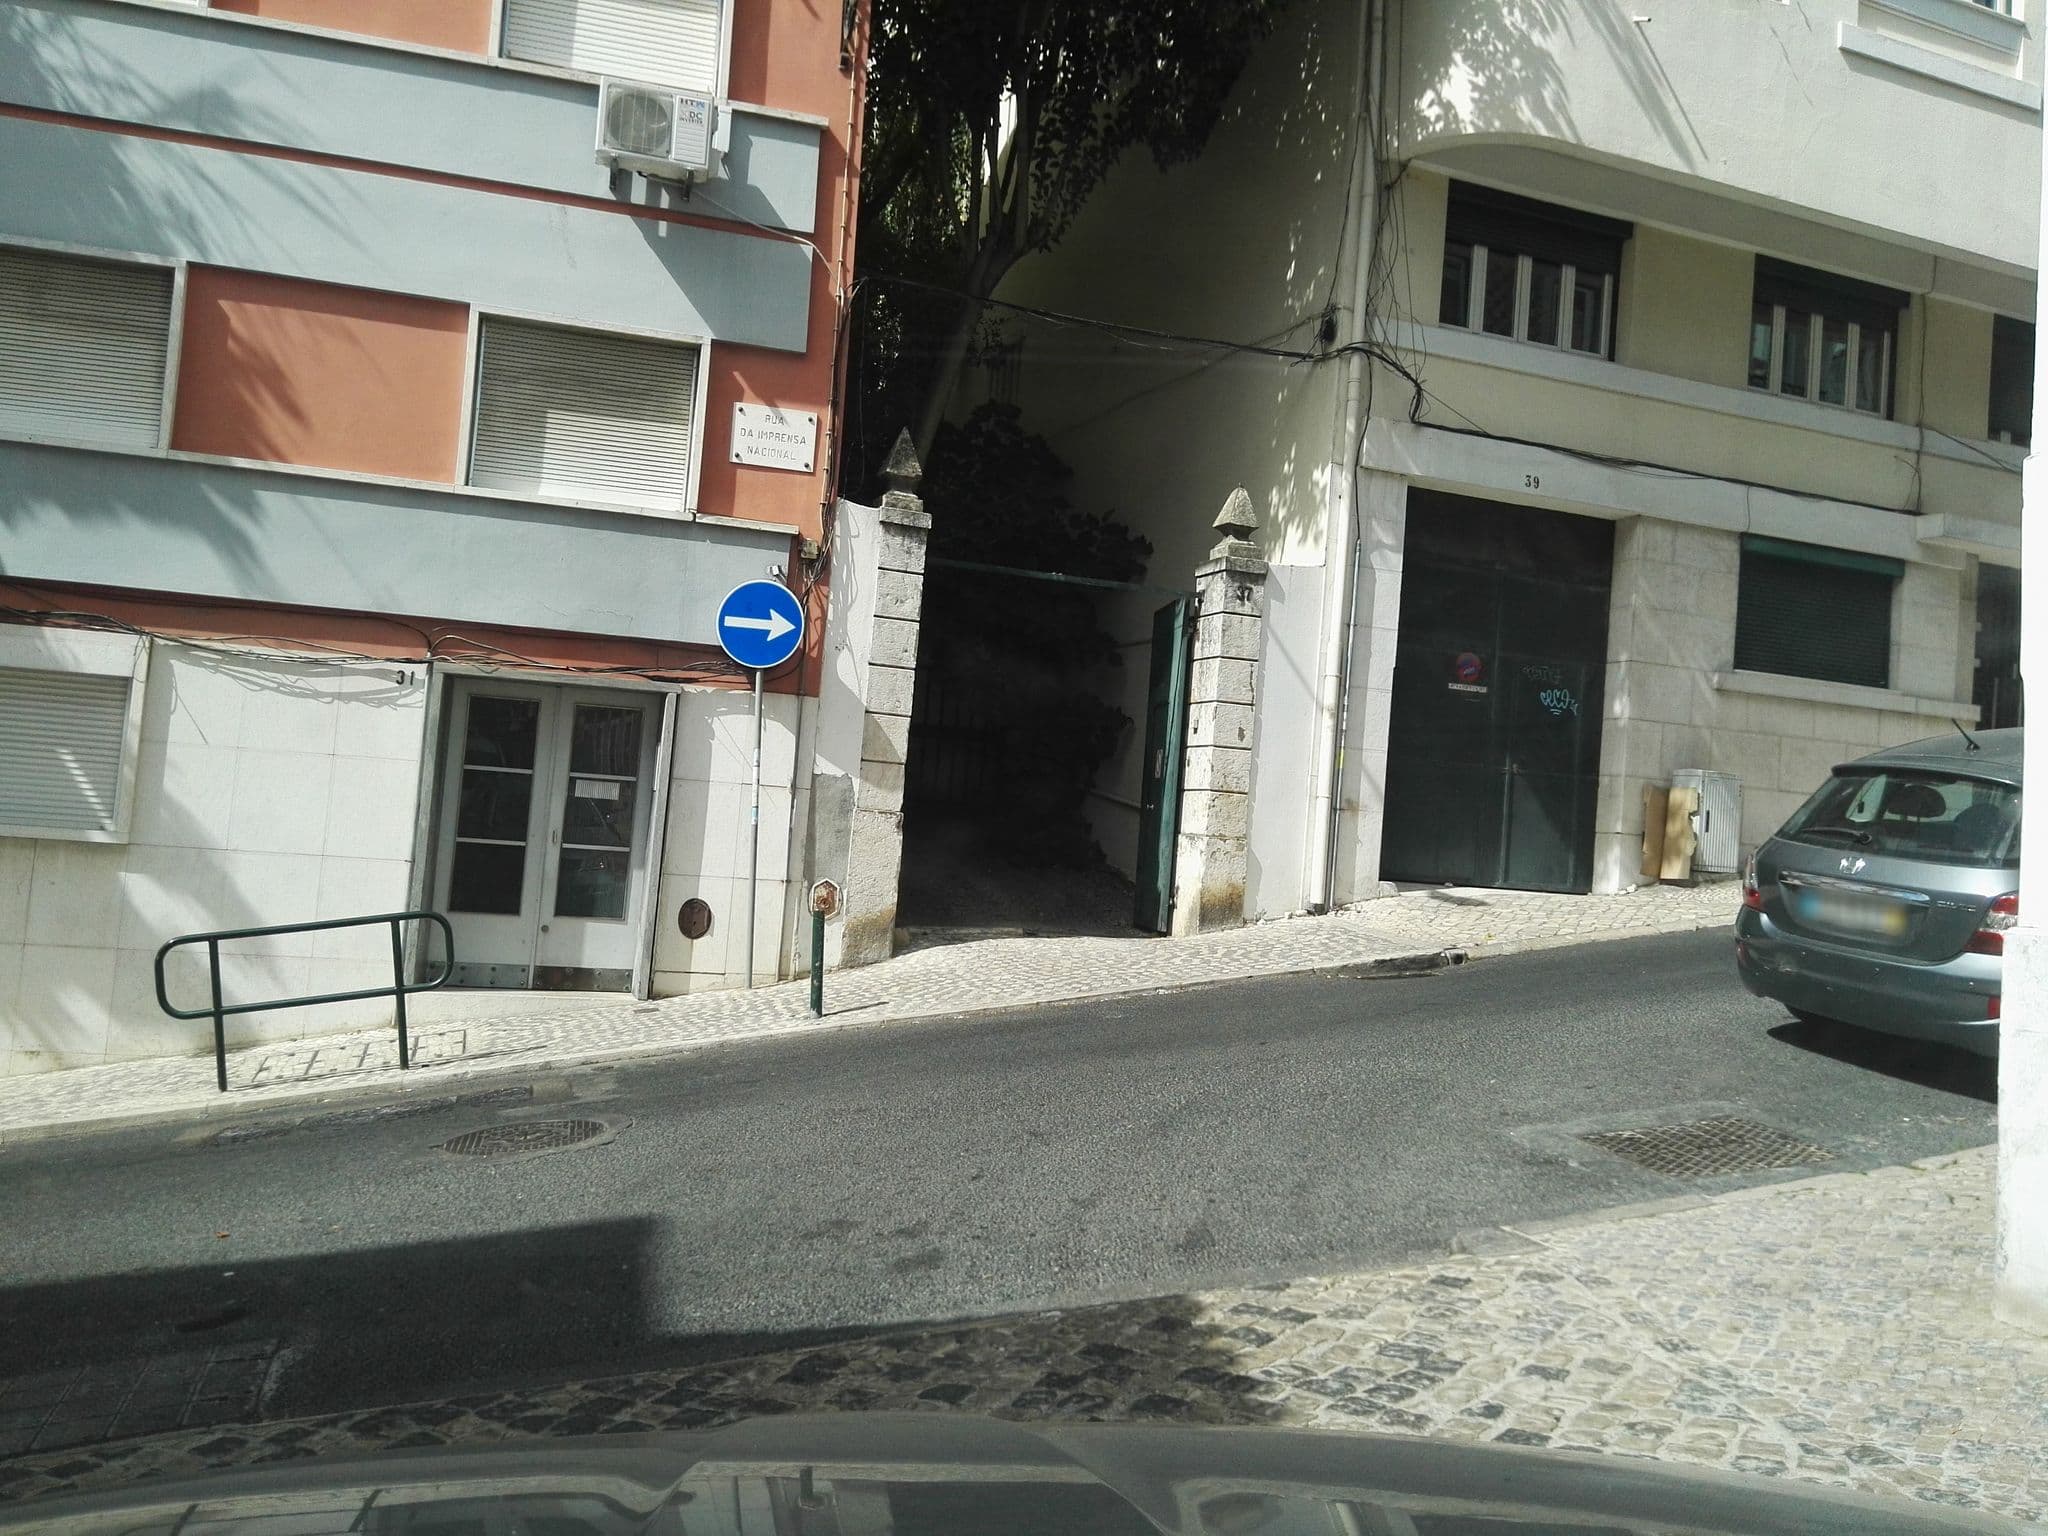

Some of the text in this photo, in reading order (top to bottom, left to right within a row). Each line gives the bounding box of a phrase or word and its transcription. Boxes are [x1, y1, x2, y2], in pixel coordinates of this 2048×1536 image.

[764, 414, 785, 426] RUA
[740, 427, 806, 445] DA IMPRENSA
[747, 446, 797, 461] NACIONAL
[1525, 474, 1540, 489] 39
[395, 669, 415, 686] 31
